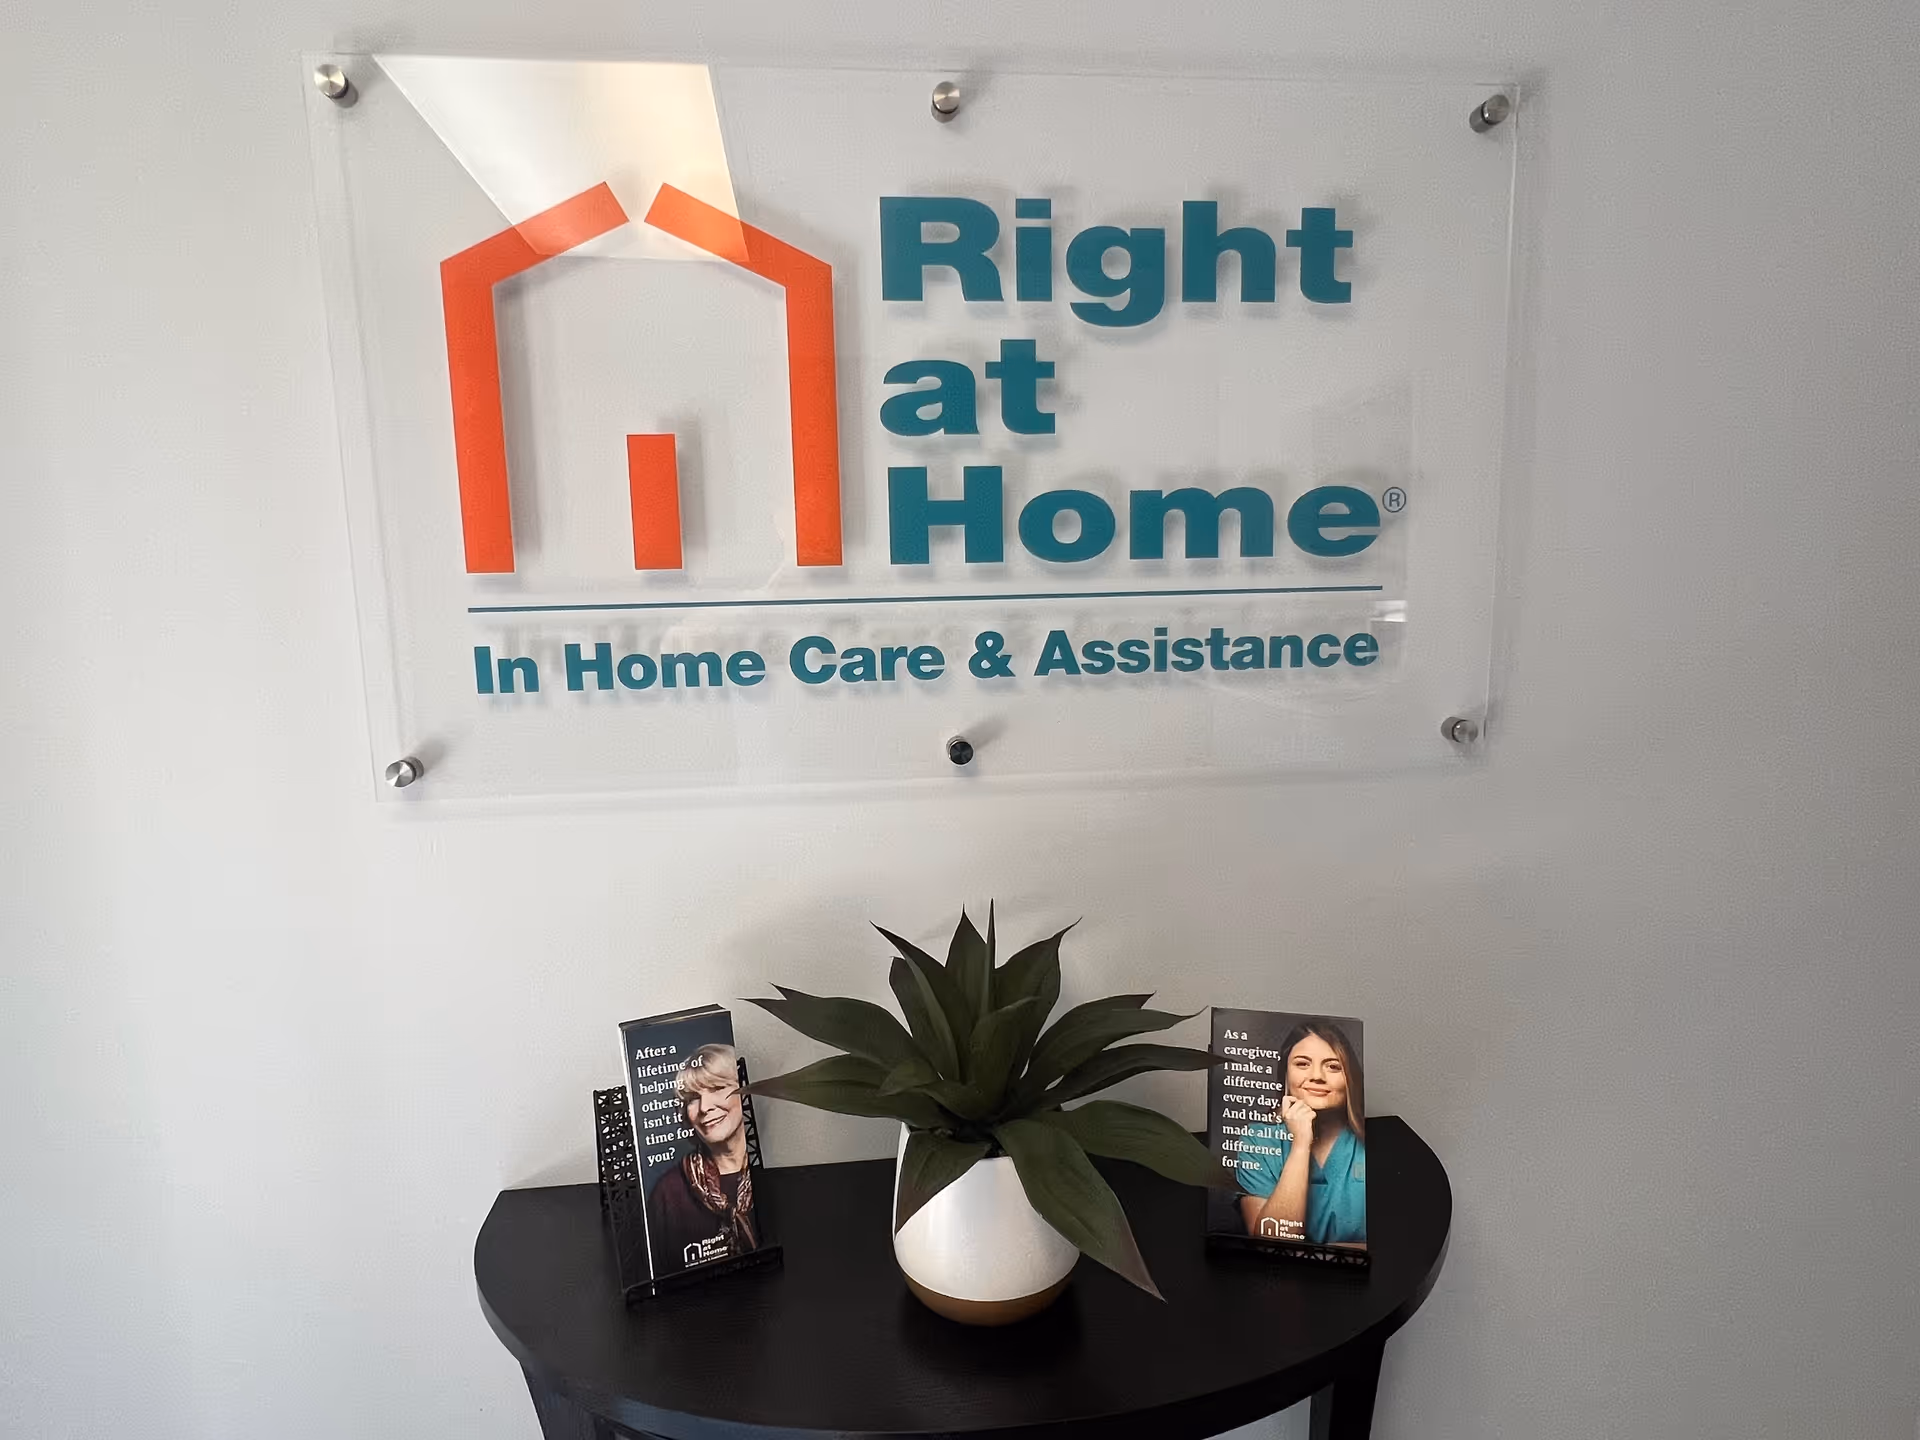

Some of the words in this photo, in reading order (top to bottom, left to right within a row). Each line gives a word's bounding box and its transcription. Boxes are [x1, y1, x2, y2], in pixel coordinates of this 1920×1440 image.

[880, 197, 1353, 327] Right
[880, 339, 1056, 436] at
[475, 645, 540, 694] In
[566, 643, 765, 691] Home
[789, 635, 944, 685] Care
[969, 630, 1013, 678] &
[1035, 627, 1379, 675] Assistance
[1224, 1029, 1238, 1039] As
[1241, 1032, 1248, 1040] a
[636, 1046, 666, 1060] After
[669, 1046, 676, 1054] a
[1224, 1046, 1281, 1061] caregiver,
[637, 1061, 686, 1078] lifetime
[691, 1056, 703, 1068] of
[1231, 1062, 1264, 1074] make
[1265, 1066, 1272, 1074] a
[640, 1079, 685, 1094] helping
[1224, 1076, 1282, 1091] difference
[642, 1098, 684, 1112] others,
[1223, 1093, 1255, 1105] every
[1258, 1095, 1280, 1108] day.
[644, 1114, 671, 1129] isn't
[672, 1113, 682, 1123] it
[1223, 1108, 1246, 1120] And
[646, 1131, 674, 1146] time
[677, 1127, 695, 1140] for
[1223, 1125, 1254, 1137] made
[1257, 1128, 1272, 1139] all
[1275, 1130, 1294, 1141] the
[1222, 1140, 1282, 1156] difference
[647, 1148, 676, 1166] you?
[1222, 1156, 1239, 1168] for
[1242, 1160, 1263, 1171] me.
